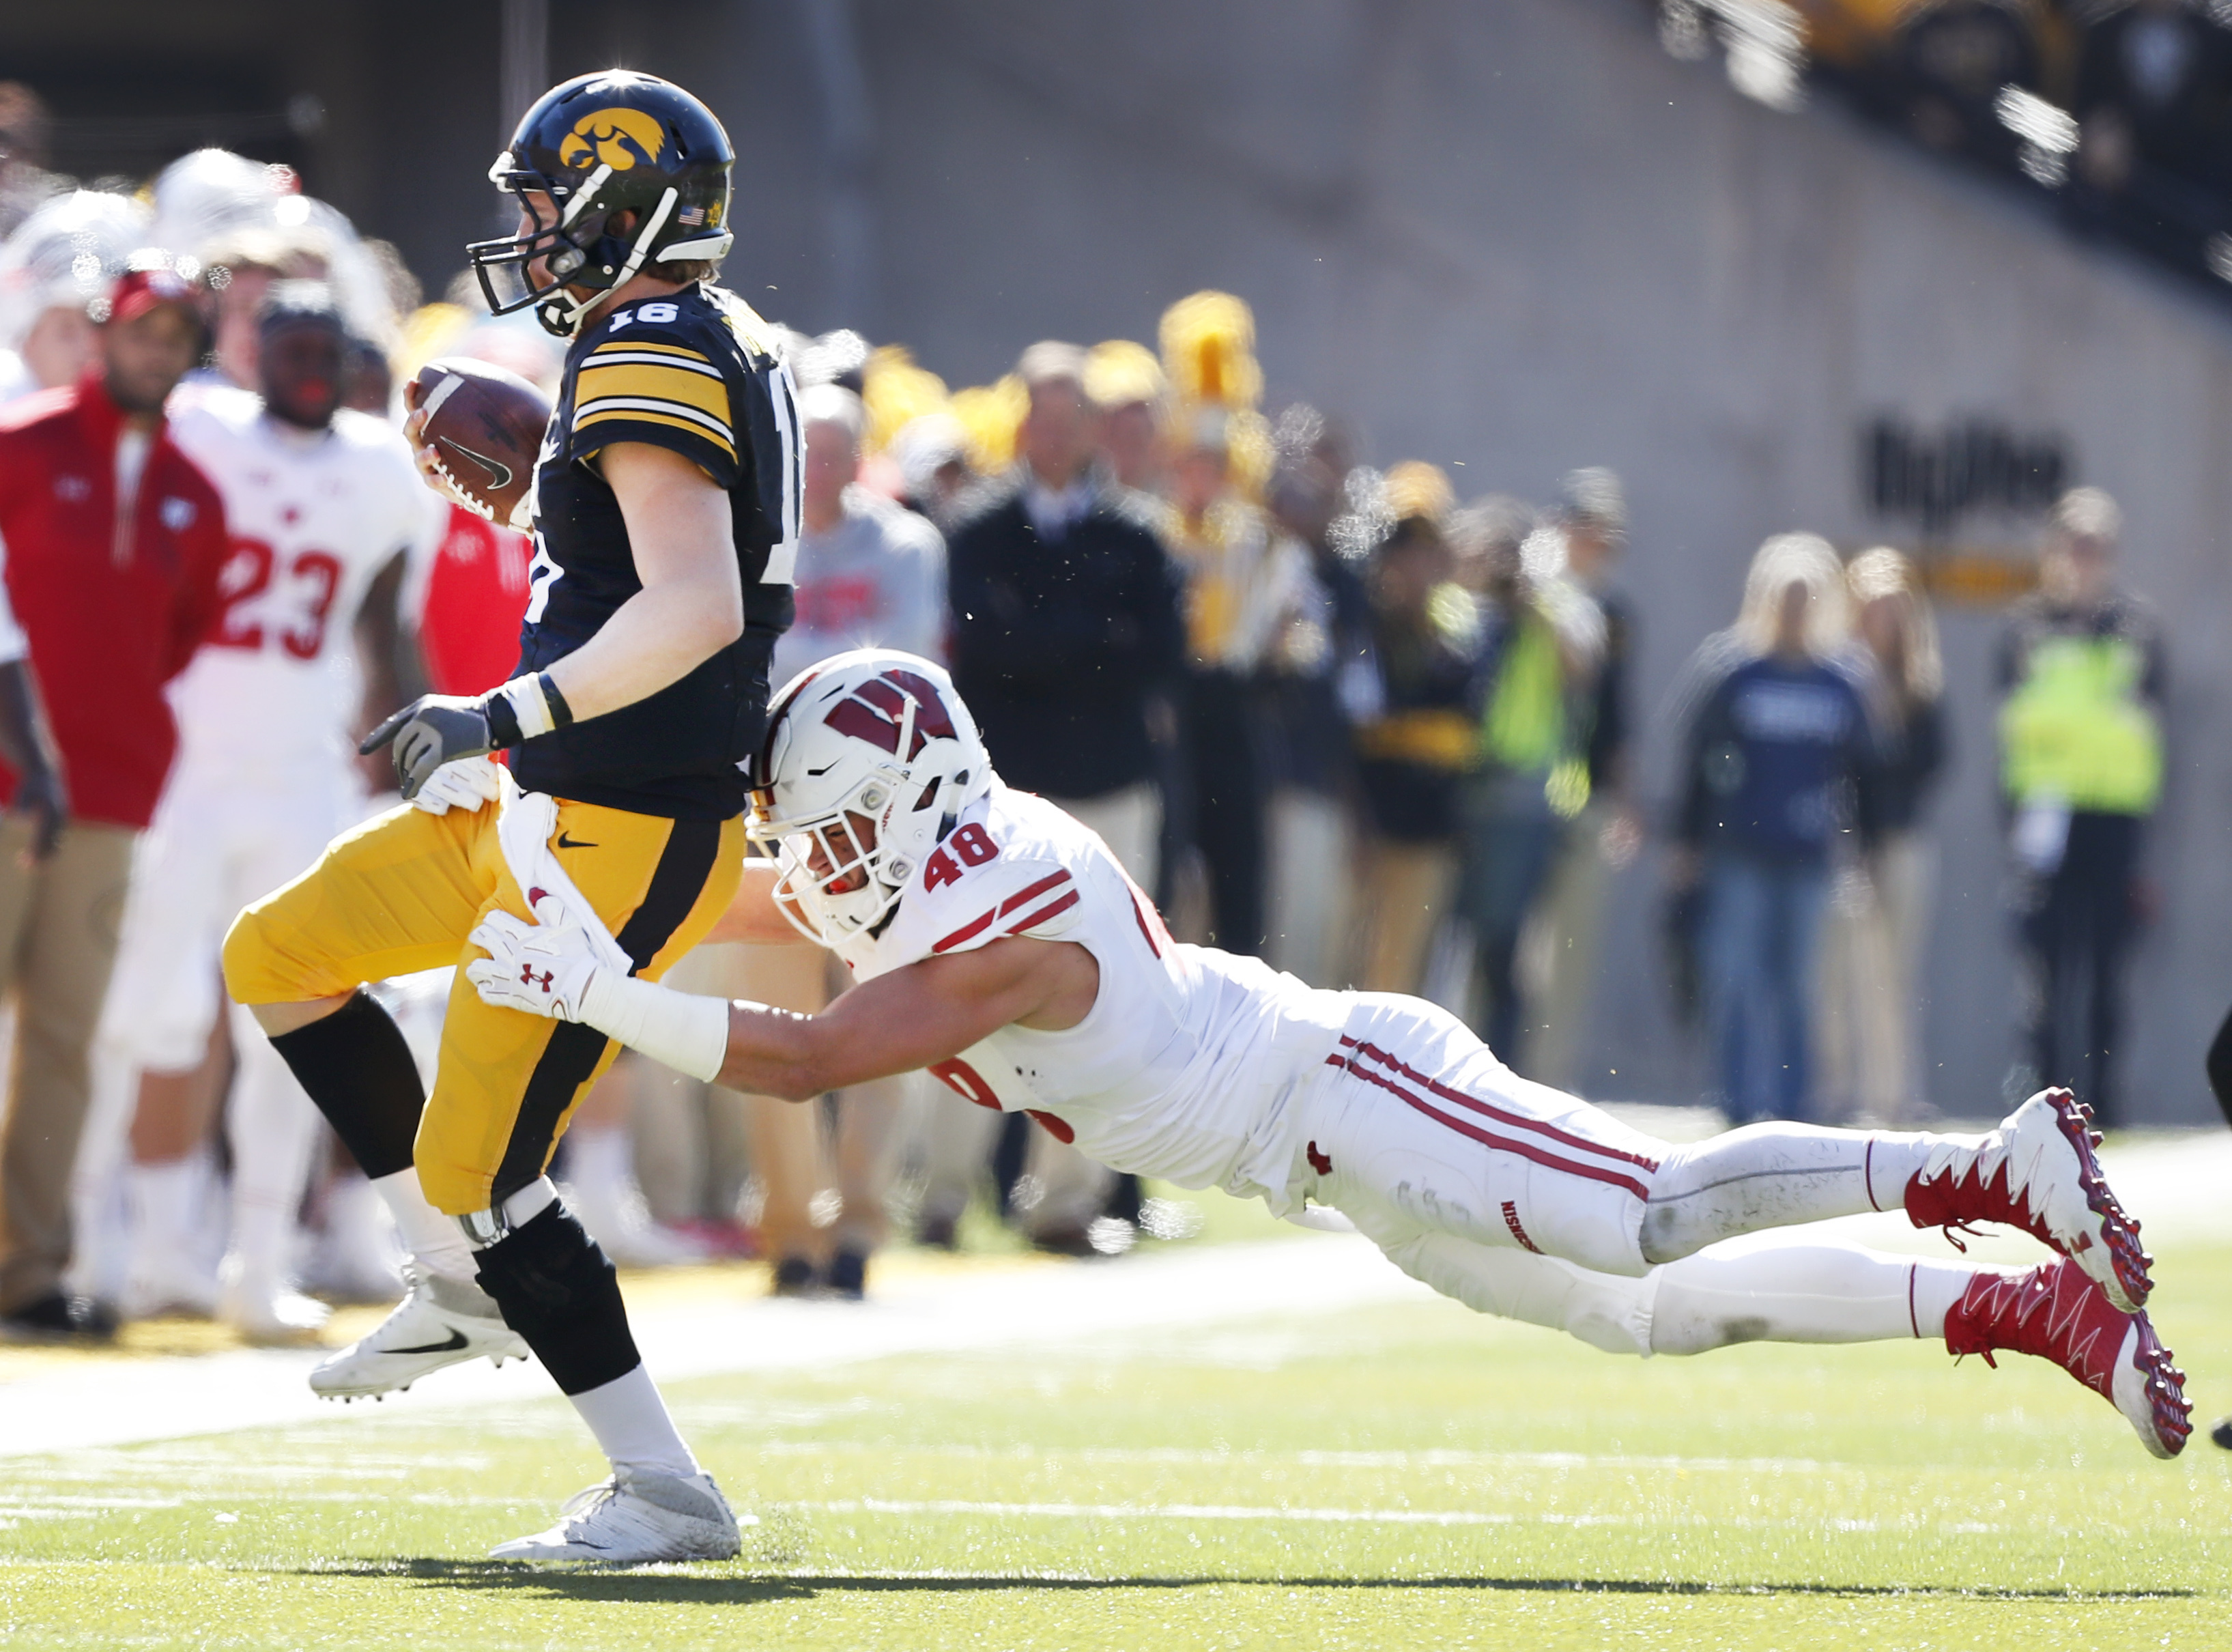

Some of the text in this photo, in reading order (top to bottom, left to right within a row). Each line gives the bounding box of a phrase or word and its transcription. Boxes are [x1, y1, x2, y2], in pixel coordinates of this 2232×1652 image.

[609, 302, 679, 332] 16
[206, 535, 343, 661] 23
[822, 668, 958, 763] W
[924, 822, 999, 894] 48
